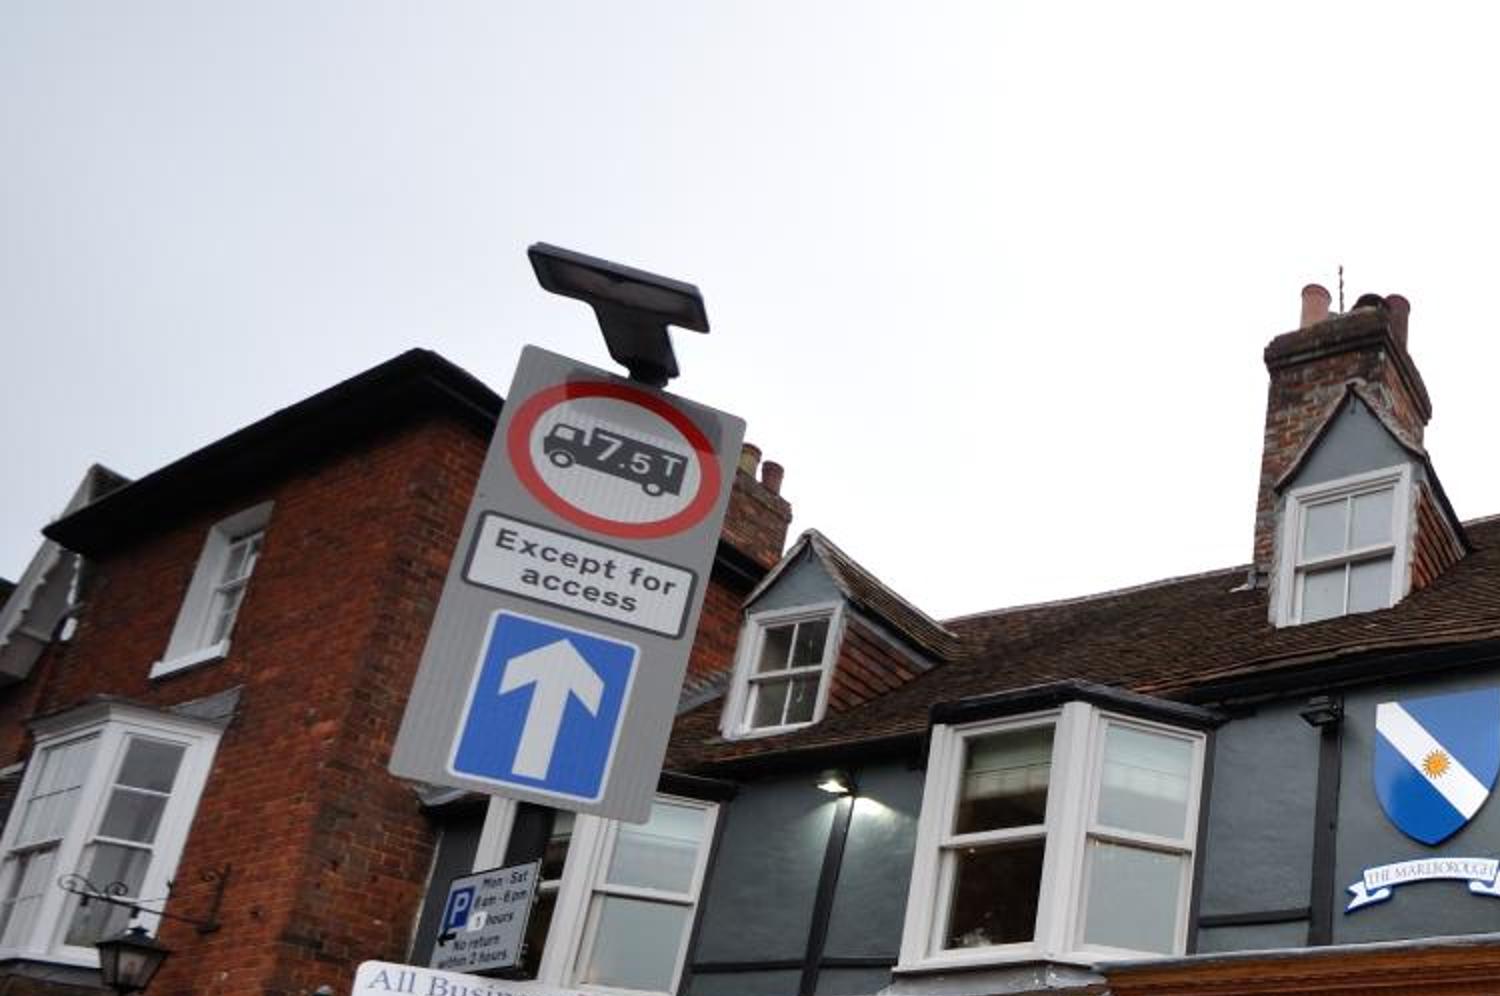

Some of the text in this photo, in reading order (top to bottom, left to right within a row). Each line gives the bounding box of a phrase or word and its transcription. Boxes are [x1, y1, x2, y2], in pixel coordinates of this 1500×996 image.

[495, 528, 676, 596] Except for
[521, 568, 637, 612] access
[509, 870, 529, 885] Sat
[449, 891, 471, 926] P
[368, 968, 417, 994] All
